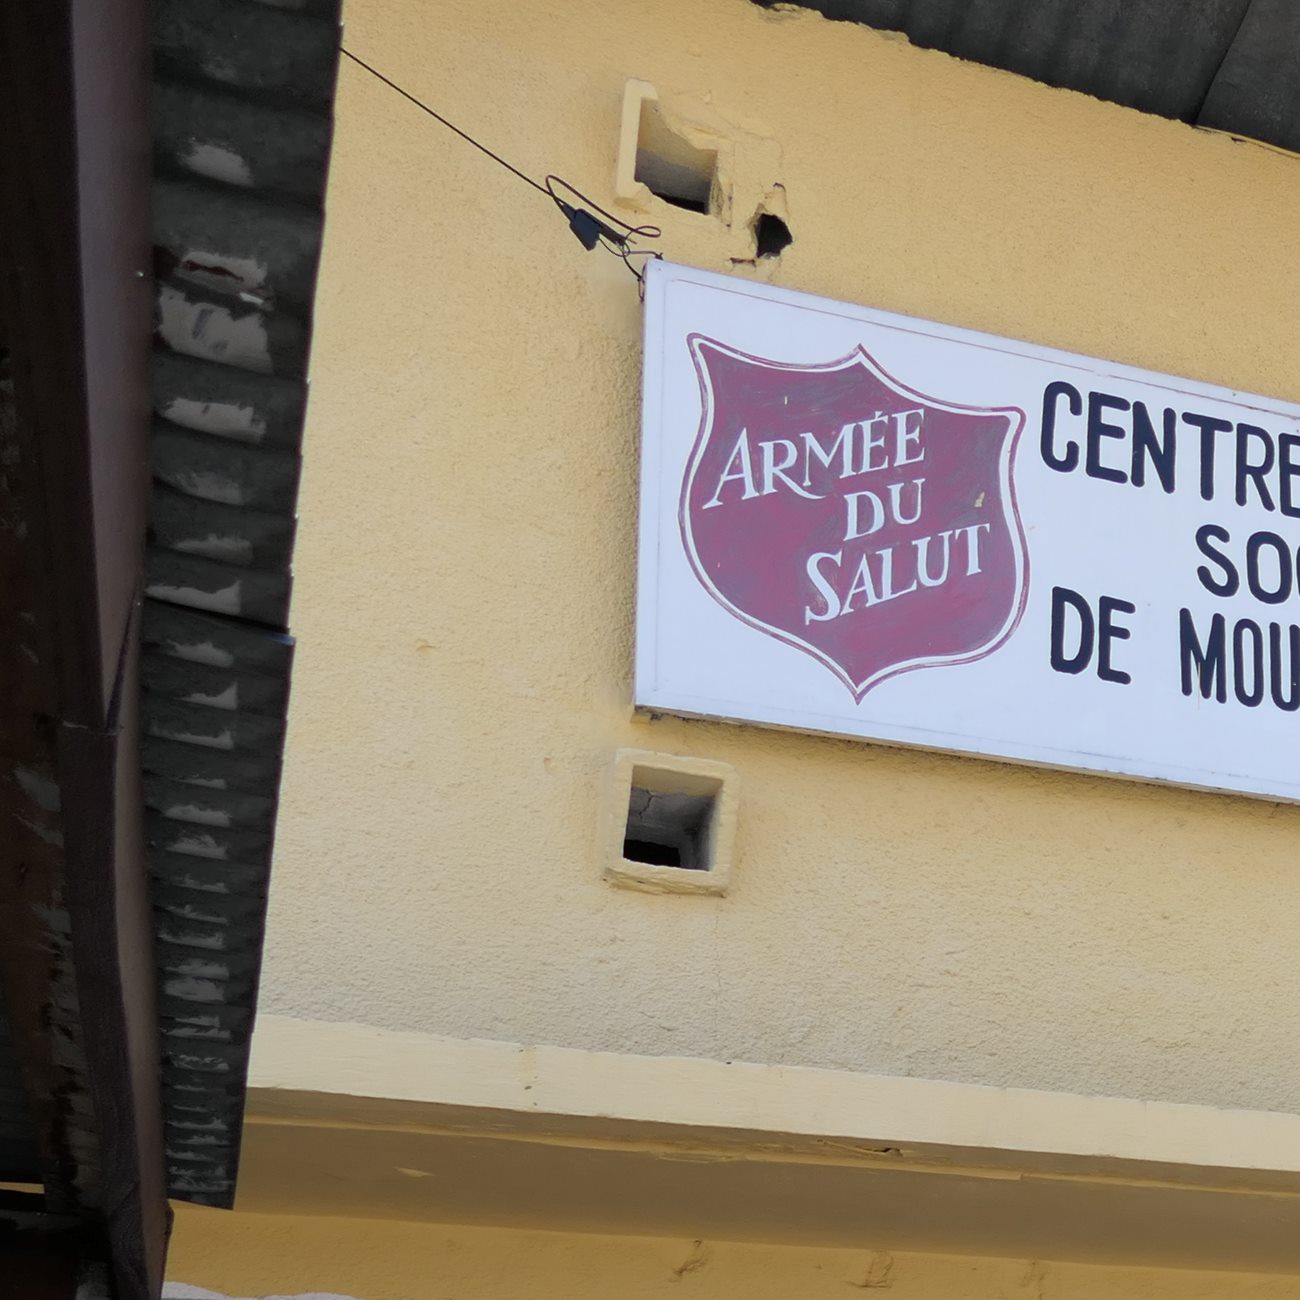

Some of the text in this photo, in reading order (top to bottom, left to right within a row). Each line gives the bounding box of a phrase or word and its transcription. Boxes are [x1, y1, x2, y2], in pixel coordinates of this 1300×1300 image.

[702, 408, 926, 510] ARMÉE
[843, 478, 926, 542] DU
[805, 523, 991, 626] SALUT
[1050, 586, 1136, 685] DE
